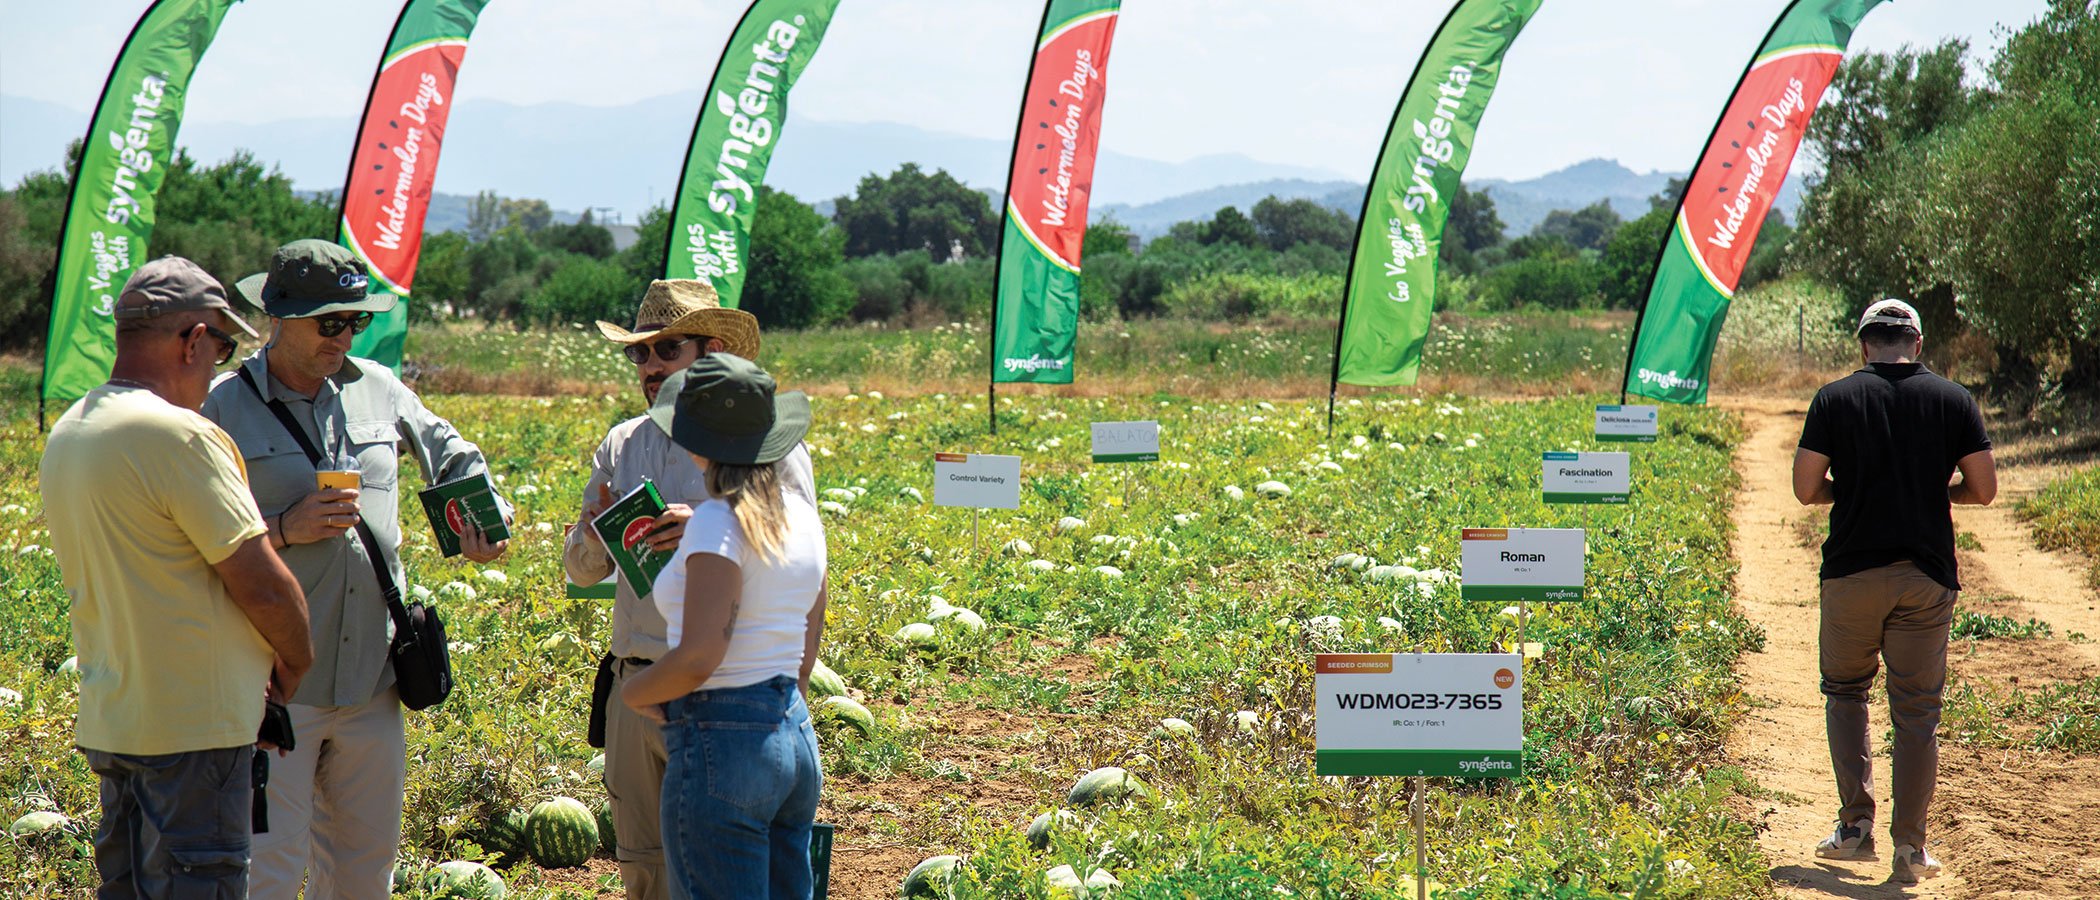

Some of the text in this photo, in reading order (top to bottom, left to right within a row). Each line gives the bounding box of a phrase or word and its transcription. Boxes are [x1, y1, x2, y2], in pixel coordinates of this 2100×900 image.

[708, 18, 800, 216] syngenta
[106, 74, 167, 225] syngenta
[1040, 49, 1098, 226] Watermelon Days
[1403, 64, 1472, 215] syngenta
[372, 72, 443, 250] Watermelon Days
[1707, 76, 1805, 249] Watermelon Days
[108, 235, 130, 271] with
[709, 229, 739, 275] with
[1405, 222, 1428, 258] with
[87, 230, 119, 317] Go Veggies
[1384, 217, 1415, 303] Go Veggies
[1004, 354, 1064, 373] syngenta
[1638, 367, 1700, 390] syngenta
[949, 473, 1006, 485] Control Variety
[1559, 467, 1614, 477] Fascination
[1500, 551, 1546, 563] Roman
[1546, 589, 1578, 600] syngenta
[1327, 661, 1390, 669] SEEDED CRIMSON
[1495, 675, 1513, 683] NEW
[1392, 719, 1403, 727] IR:
[1403, 719, 1415, 727] Co:
[1426, 719, 1440, 727] Fon:
[1459, 758, 1513, 773] syngenta
